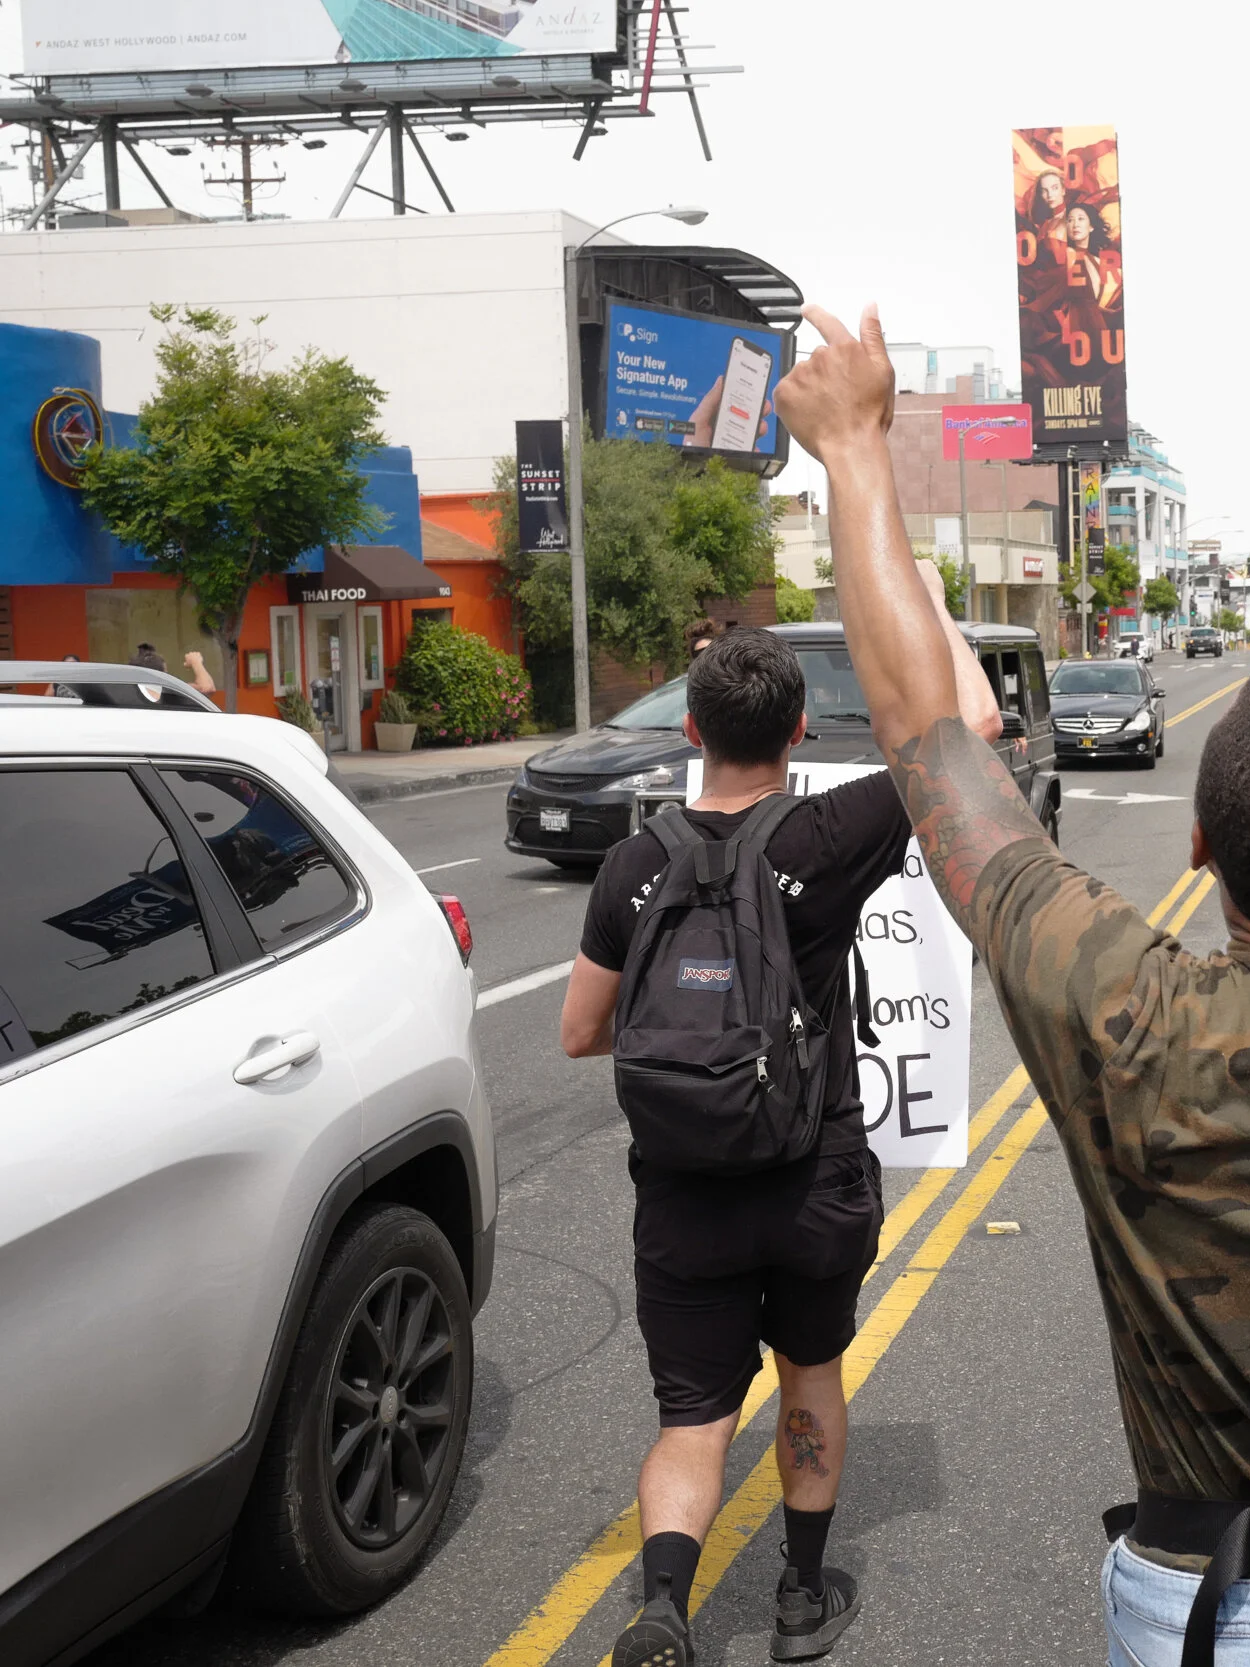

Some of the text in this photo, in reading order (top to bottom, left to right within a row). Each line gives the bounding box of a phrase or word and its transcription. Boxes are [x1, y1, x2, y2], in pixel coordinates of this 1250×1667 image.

[45, 40, 80, 49] ANDAZ
[84, 38, 110, 47] WEST
[114, 36, 176, 47] HOLLYWOOD
[636, 327, 659, 344] Sign
[1053, 303, 1125, 367] YOU
[616, 351, 666, 371] Your New
[616, 367, 688, 391] Signature App
[1043, 384, 1103, 416] KILLING EVE
[946, 419, 971, 430] Bank
[521, 470, 561, 478] SUNSET
[521, 482, 561, 491] STRIP
[302, 588, 367, 602] THAI FOOD
